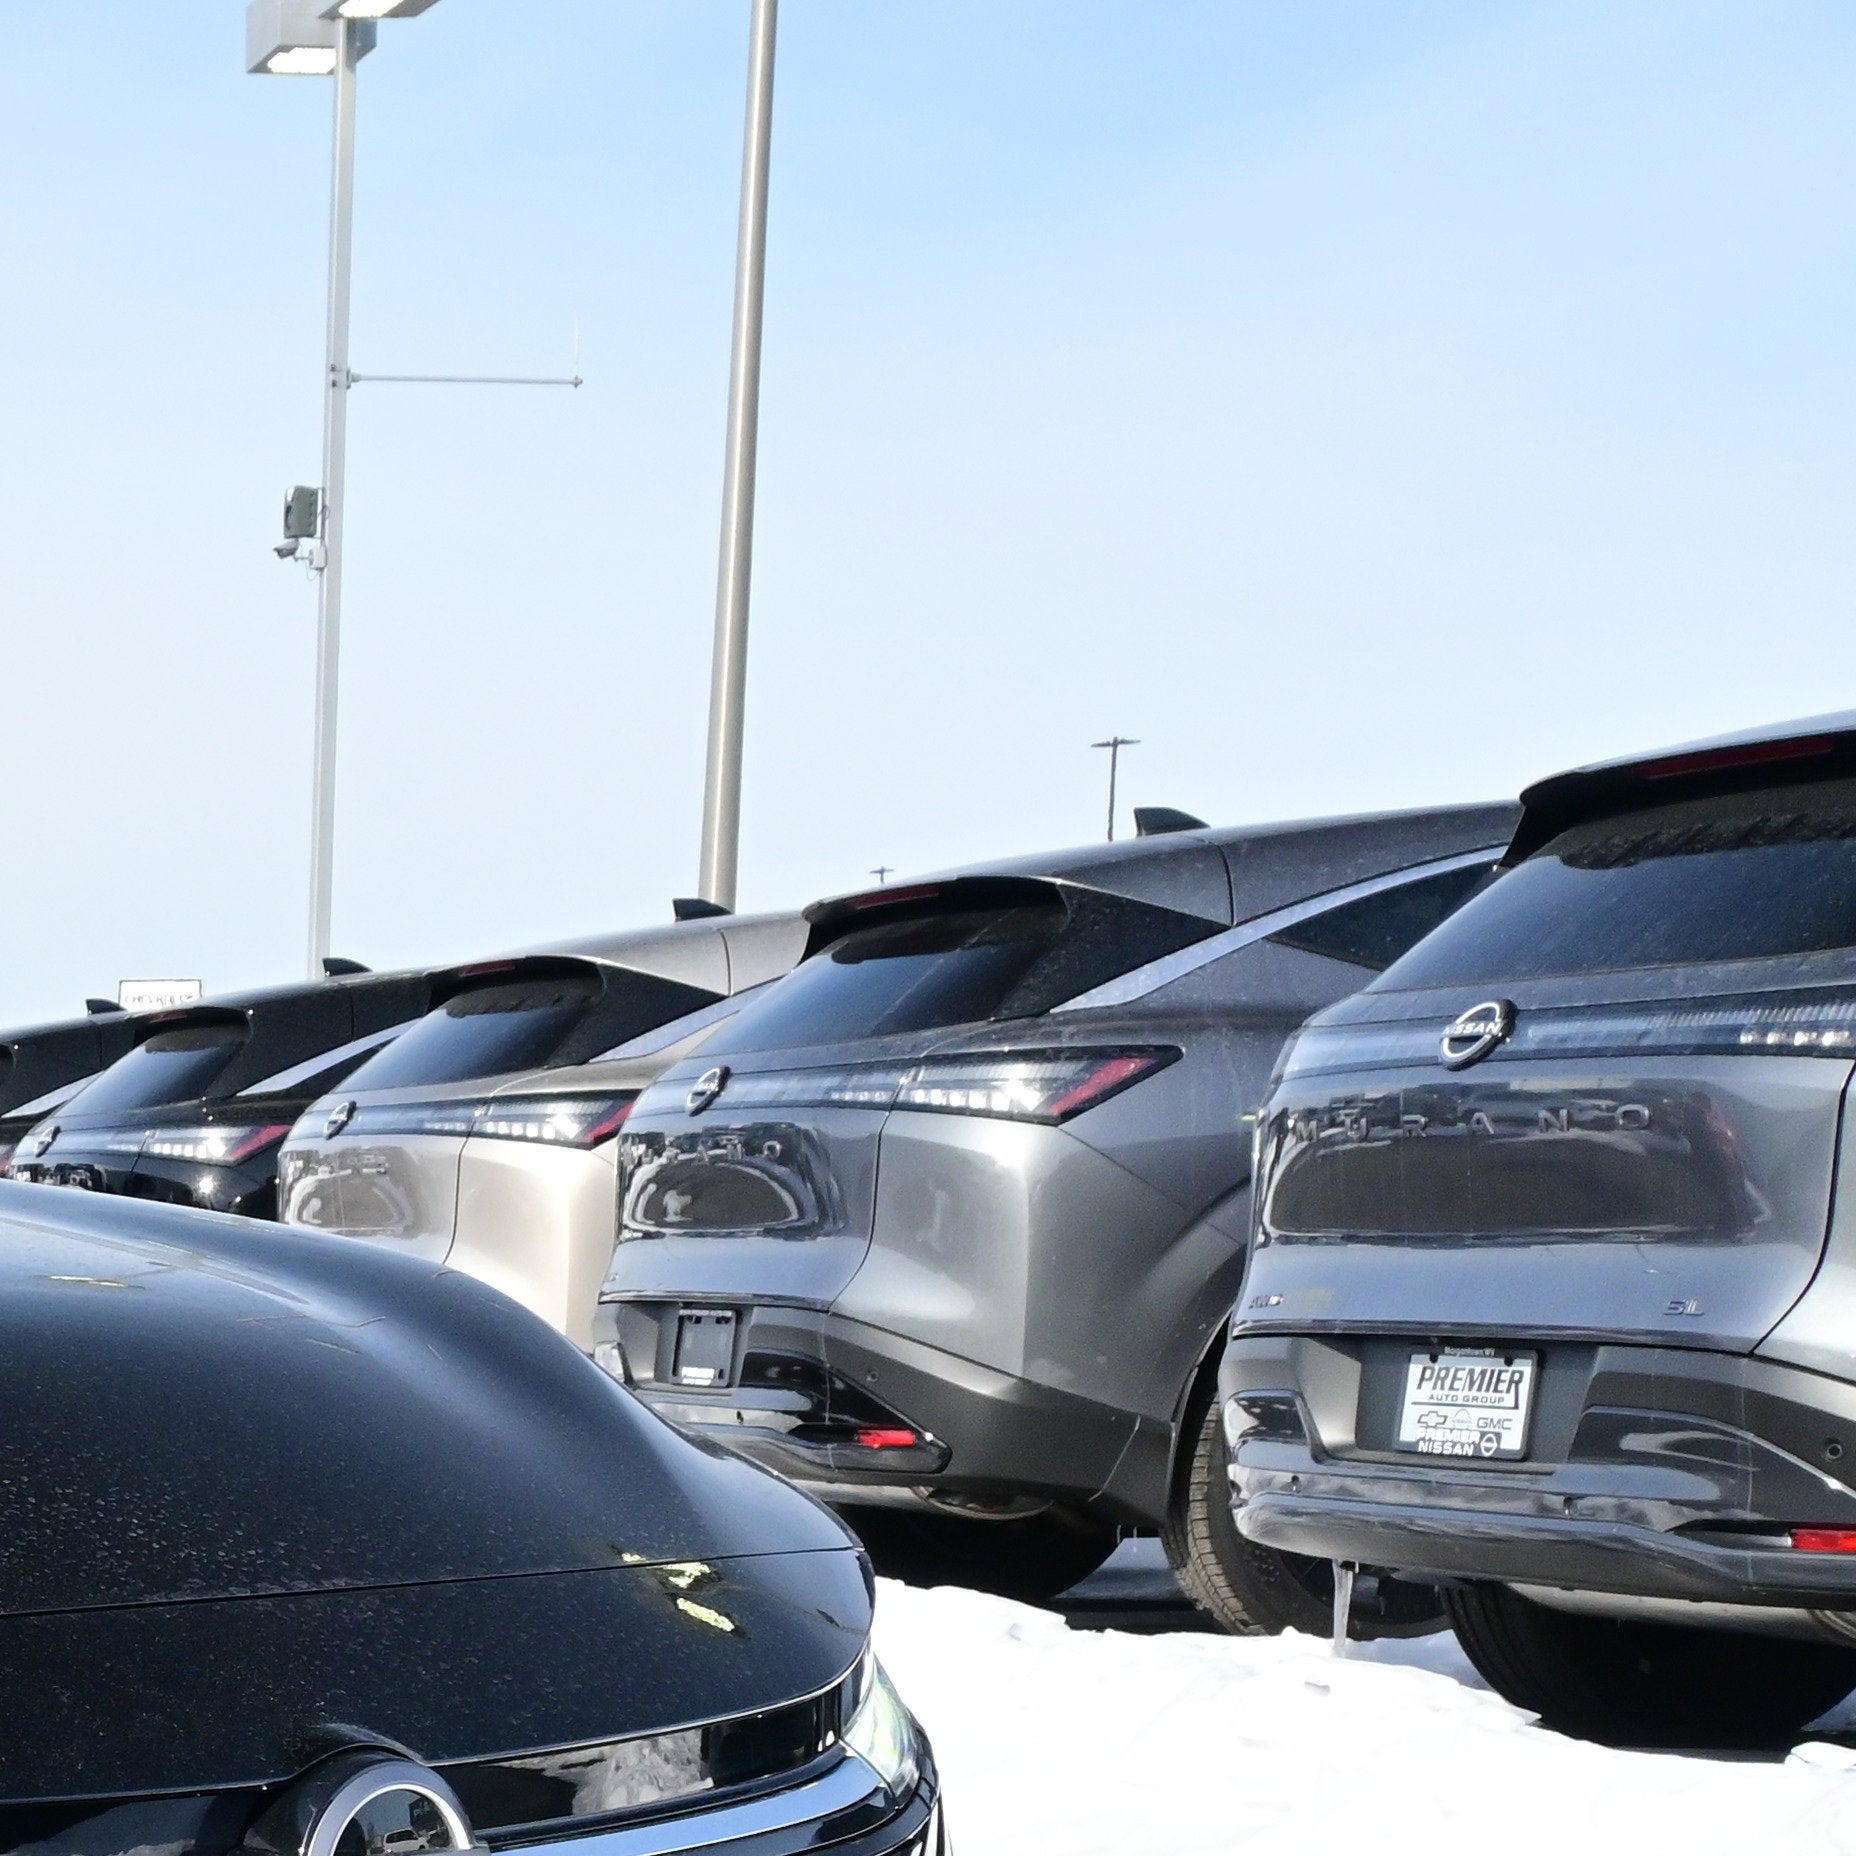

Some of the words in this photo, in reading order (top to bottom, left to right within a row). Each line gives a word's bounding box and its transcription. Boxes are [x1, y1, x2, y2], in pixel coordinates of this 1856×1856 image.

[1293, 1103, 1653, 1142] MURANO
[1416, 1366, 1524, 1409] PREMIER
[1428, 1394, 1458, 1402] AUTO
[1462, 1395, 1505, 1405] GROUP
[1476, 1417, 1513, 1430] GMC
[1416, 1428, 1480, 1443] PREMIER
[1418, 1441, 1474, 1456] NISSAN
